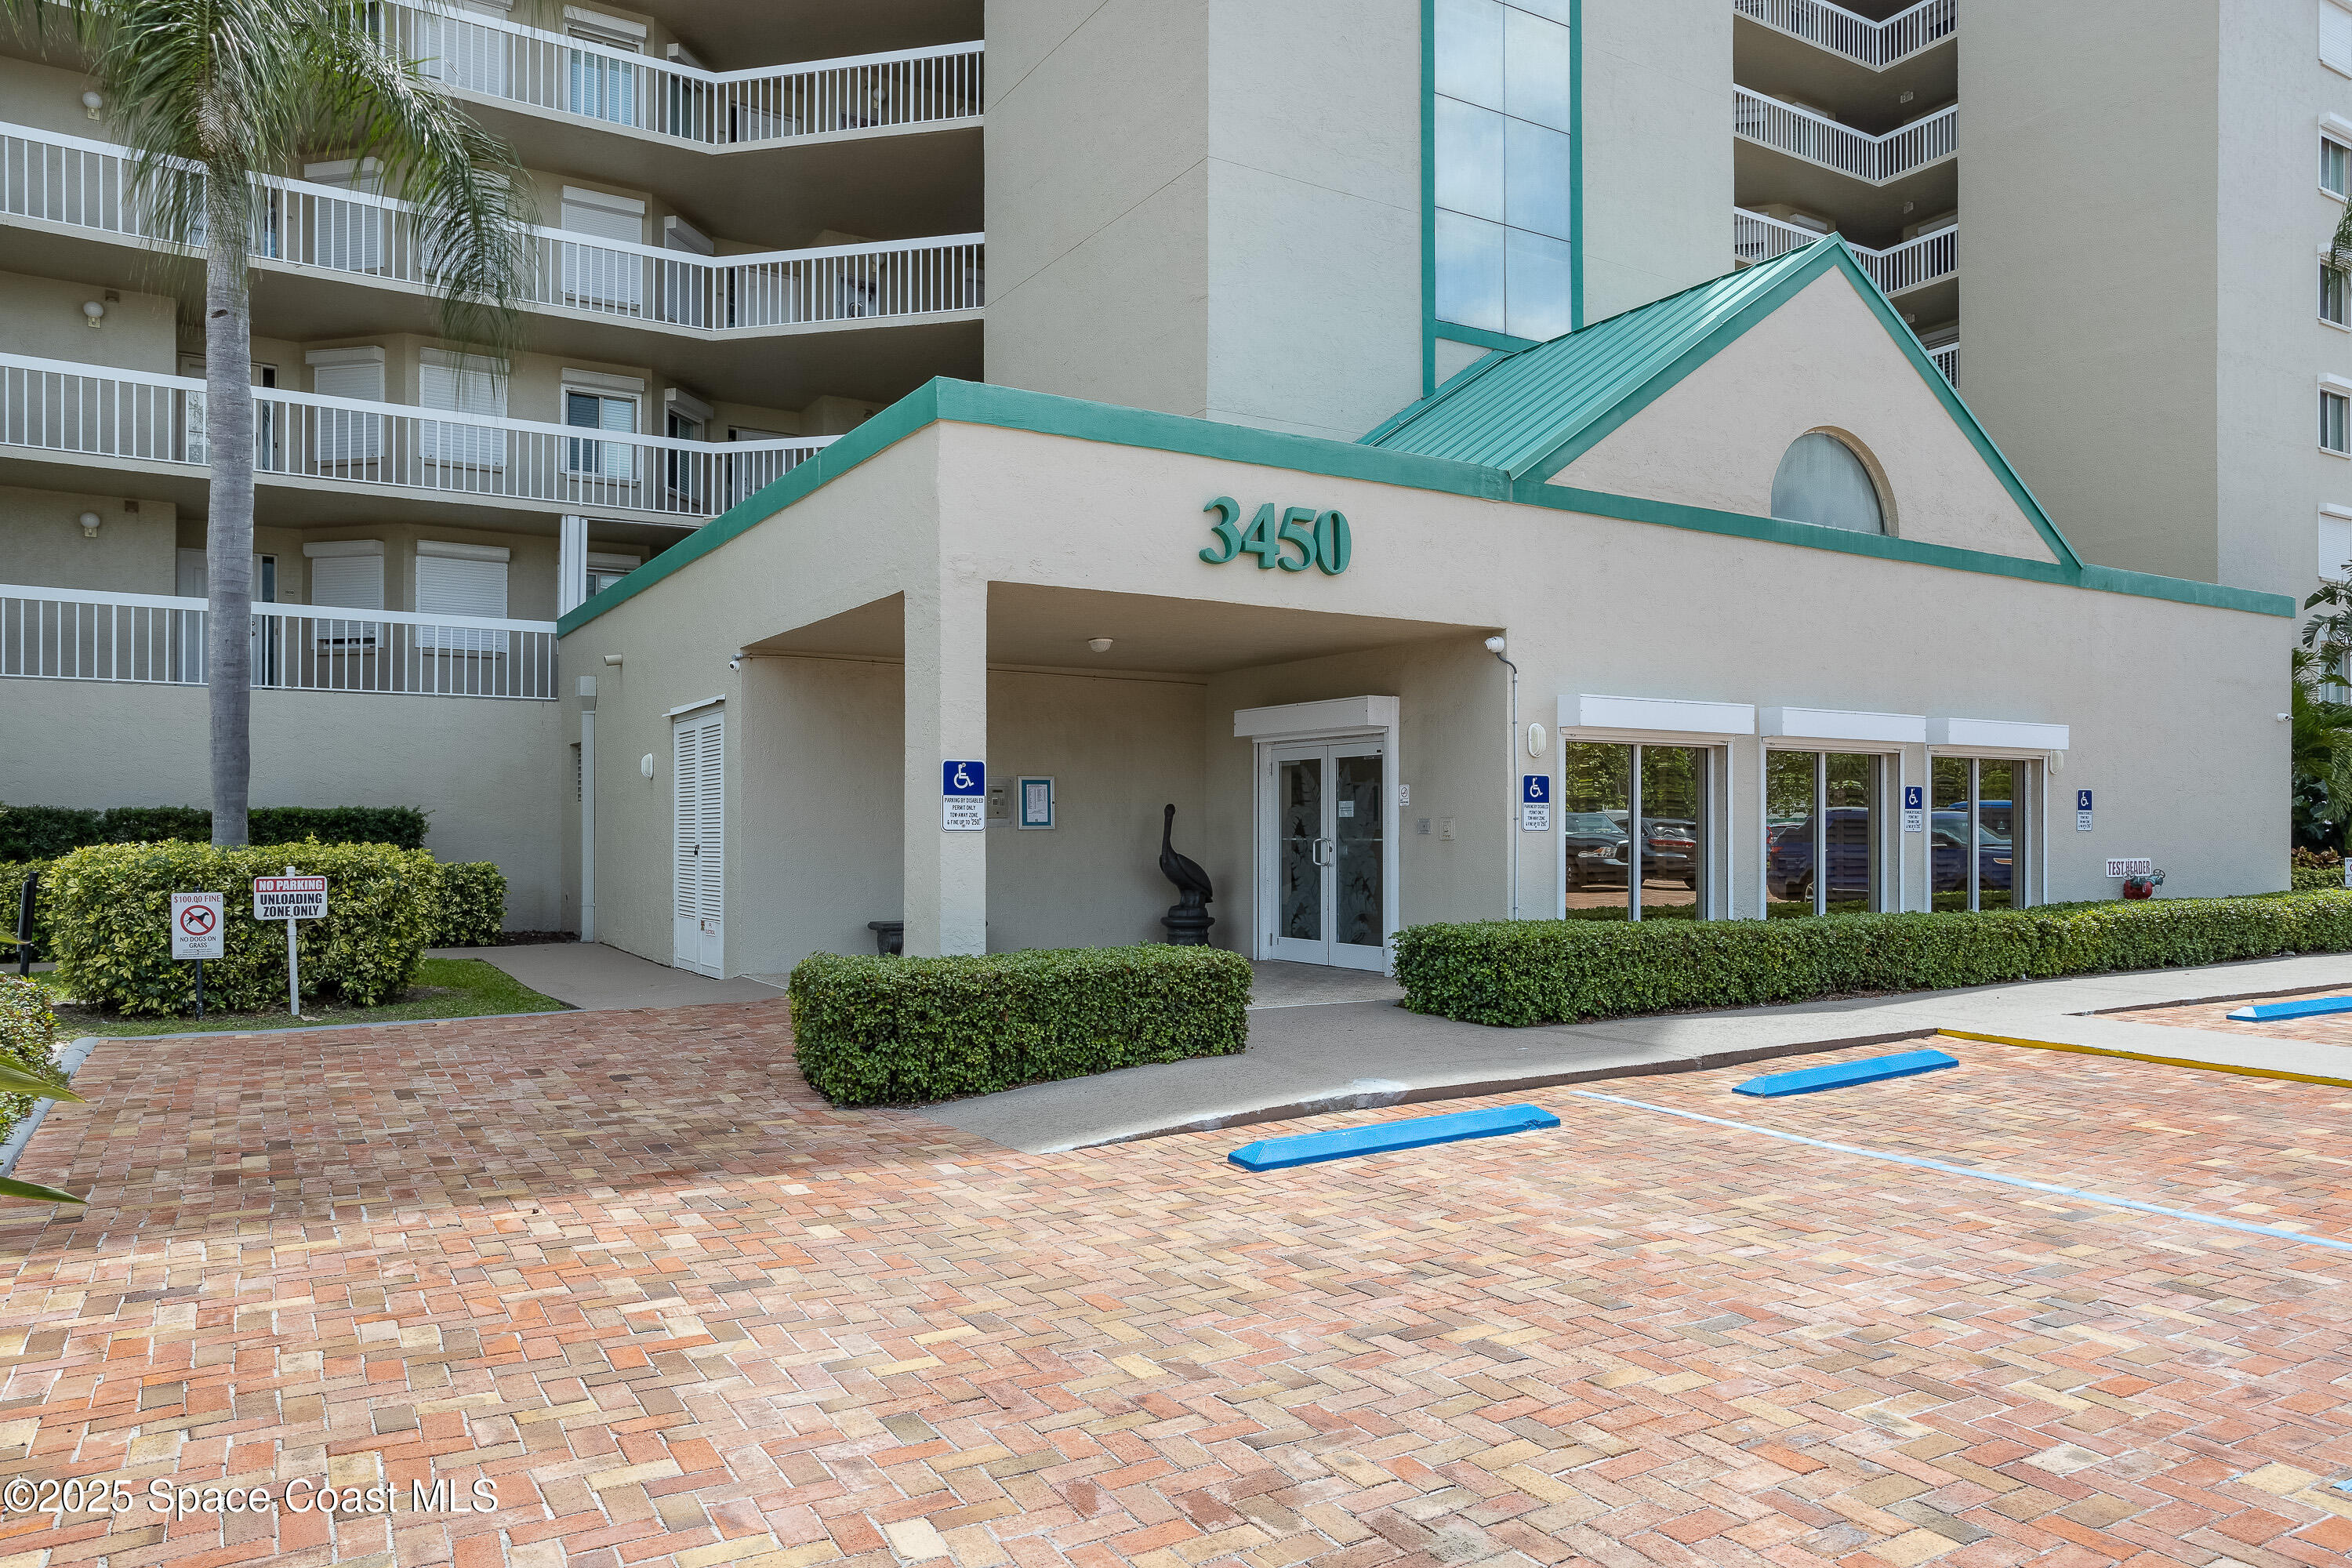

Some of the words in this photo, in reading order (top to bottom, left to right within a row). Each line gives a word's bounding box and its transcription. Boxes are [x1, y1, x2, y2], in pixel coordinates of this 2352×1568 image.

[1199, 496, 1352, 576] 3450
[2107, 861, 2125, 876] TEST
[2125, 860, 2151, 875] HEADER
[259, 880, 274, 891] NO
[276, 880, 323, 891] PARKING
[260, 893, 322, 906] UNLOADING
[263, 906, 291, 917] ZONE
[292, 905, 319, 916] ONLY
